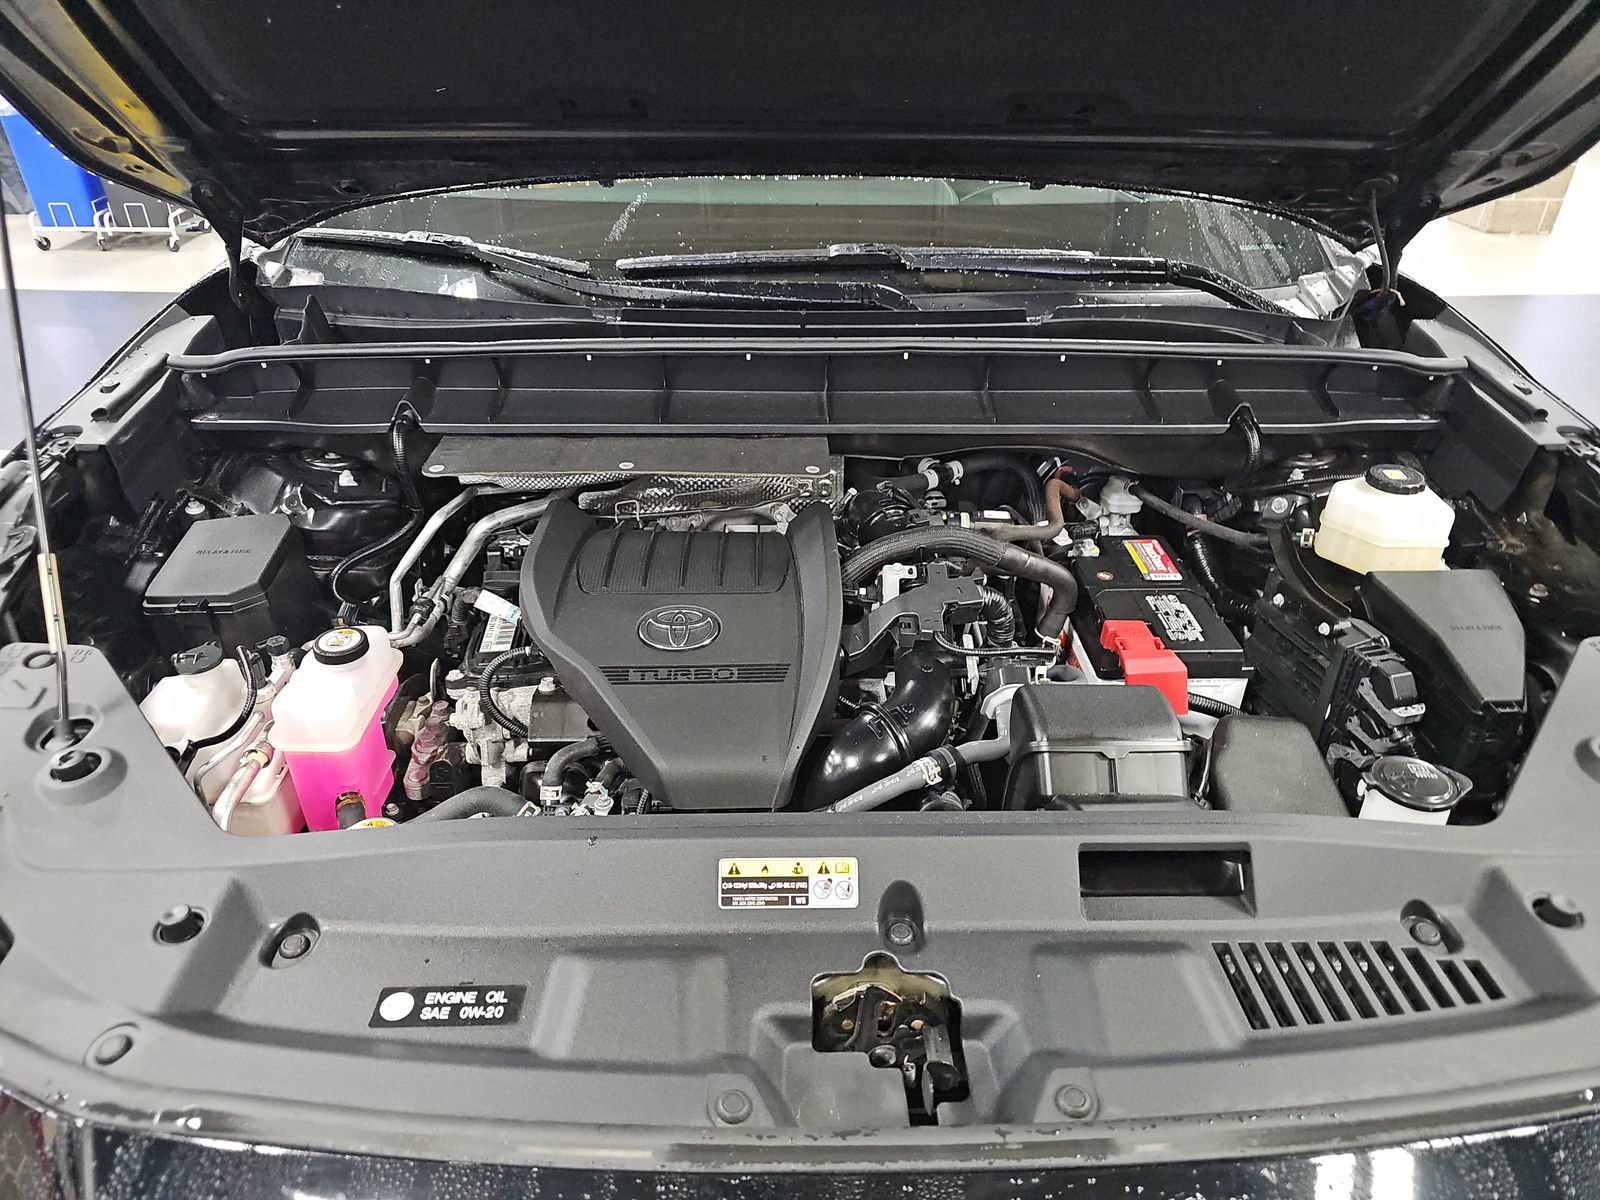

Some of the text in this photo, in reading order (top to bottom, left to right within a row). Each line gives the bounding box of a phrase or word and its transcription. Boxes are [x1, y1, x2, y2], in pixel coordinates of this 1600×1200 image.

[632, 667, 734, 681] TURBO
[424, 990, 508, 1005] ENGINE OIL
[419, 1005, 505, 1020] SAE 0W-20
